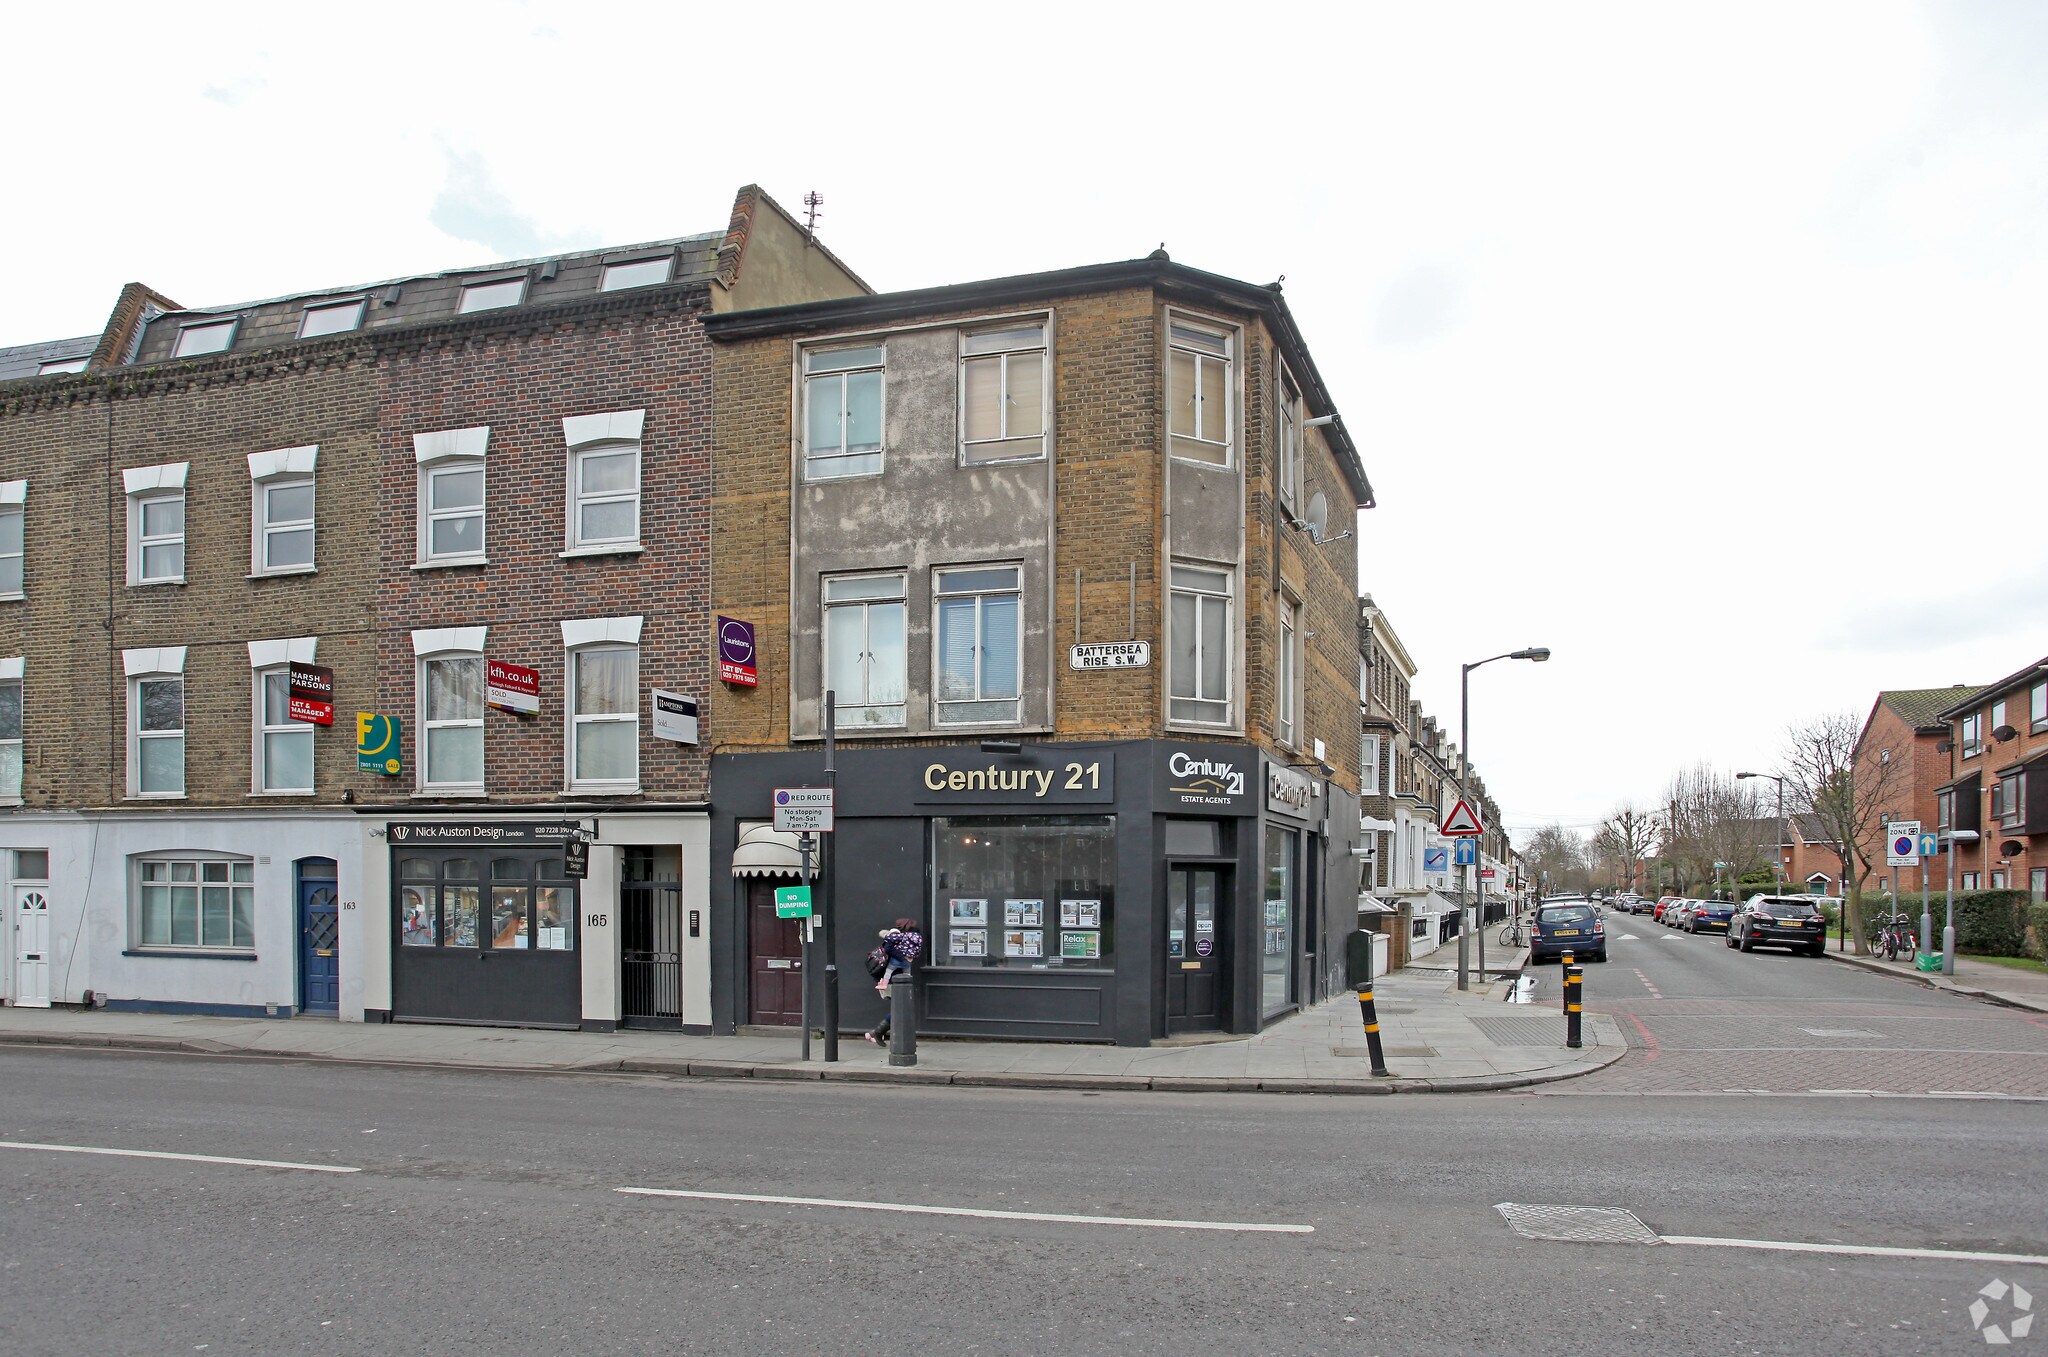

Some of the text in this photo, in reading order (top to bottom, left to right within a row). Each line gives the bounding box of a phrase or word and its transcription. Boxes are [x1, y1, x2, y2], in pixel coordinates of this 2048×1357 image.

[1077, 645, 1142, 656] BATTERSEA
[1083, 655, 1138, 666] RISE S.W.
[722, 664, 733, 672] LET
[291, 671, 320, 682] MARSH
[490, 666, 533, 685] kfh.co.uk
[291, 678, 331, 691] PARSONS
[291, 707, 324, 716] MANAGED
[657, 719, 668, 727] Sold
[1169, 752, 1244, 795] Century 21
[924, 762, 1100, 797] Century 21
[1274, 774, 1303, 811] Century
[1181, 795, 1231, 804] ESTATE AGENTS
[415, 827, 437, 837] Nick
[438, 827, 471, 837] Auston
[473, 826, 504, 839] Design
[343, 902, 356, 910] 163
[587, 914, 607, 927] 165
[1063, 935, 1086, 943] Relax
